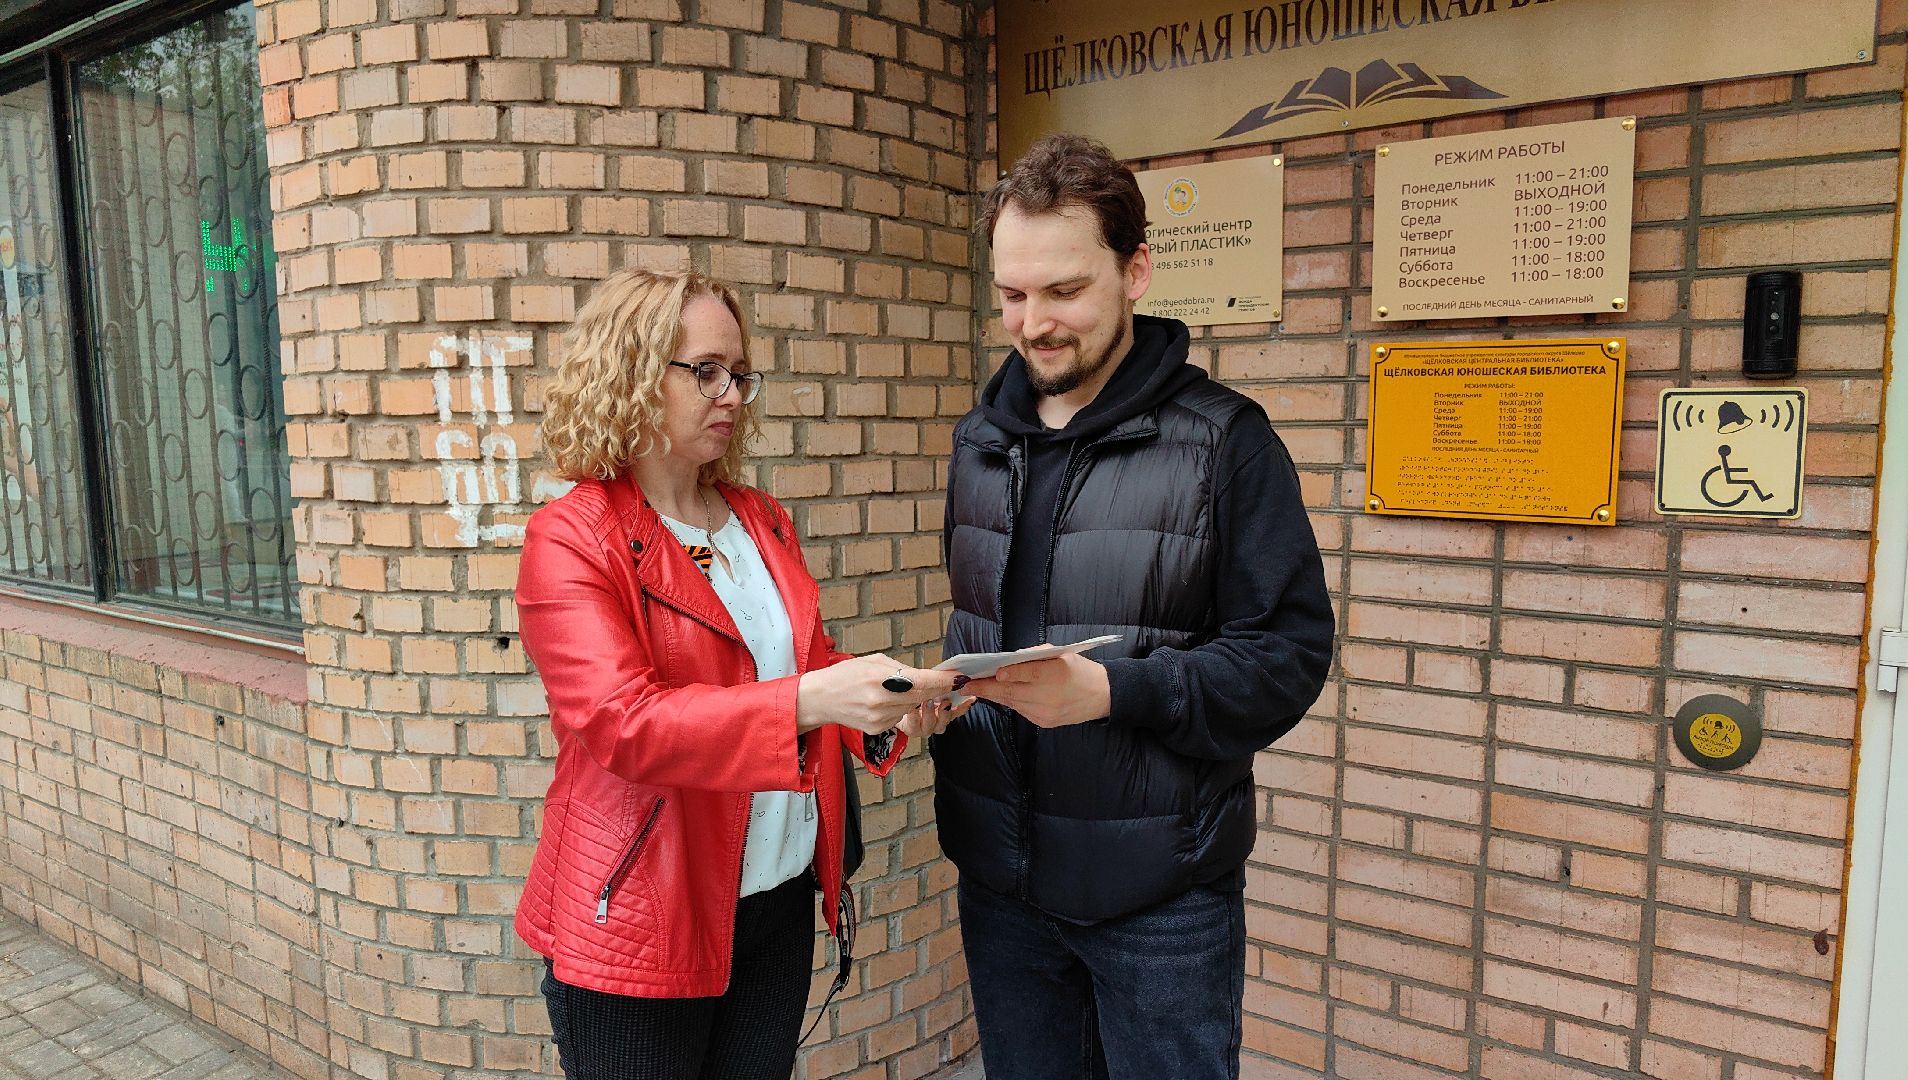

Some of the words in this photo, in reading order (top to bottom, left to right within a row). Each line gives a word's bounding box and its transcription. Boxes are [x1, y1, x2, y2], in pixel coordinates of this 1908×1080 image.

[1024, 14, 1233, 99] ЩЁЛКОВСКАЯ
[1434, 149, 1492, 166] РЕЖИМ
[1498, 141, 1564, 159] РАБОТЫ
[1402, 178, 1496, 195] Понедельник
[1516, 170, 1553, 184] 11:00
[1569, 166, 1608, 180] 21:00
[1401, 198, 1458, 210] Вторник
[1514, 180, 1605, 201] ВЫХОДНОЙ
[1400, 215, 1441, 227] Среда
[1514, 204, 1552, 217] 11:00
[1569, 200, 1607, 213] 19:00
[1213, 220, 1252, 233] центр
[1400, 230, 1454, 241] Четверг
[1514, 220, 1551, 234] 11:00
[1567, 216, 1606, 230] 21:00
[1181, 235, 1251, 252] ПЛАСТИК»
[1400, 246, 1455, 257] Пятница
[1513, 237, 1550, 250] 11:00
[1568, 233, 1605, 246] 19:00
[1174, 260, 1188, 268] 562
[1191, 259, 1200, 267] 51
[1203, 258, 1213, 266] 18
[1399, 260, 1453, 274] Суббота
[1512, 254, 1549, 266] 11:00
[1566, 250, 1604, 262] 18:00
[1399, 275, 1485, 288] Воскресенье
[1512, 270, 1548, 282] 11:00
[1566, 267, 1604, 279] 18:00
[1147, 297, 1214, 307] info@geodobra.ru
[1403, 300, 1457, 311] ПОСЛЕДНИЙ
[1458, 300, 1482, 309] ДЕНЬ
[1484, 299, 1521, 308] МЕСЯЦА
[1528, 294, 1594, 306] САНИТАРНЫЙ
[1384, 367, 1454, 378] ЩЁЛКОВСКАЯ
[1457, 367, 1527, 376] ЮНОШЕСКАЯ
[1530, 366, 1606, 375] БИБЛИОТЕКА
